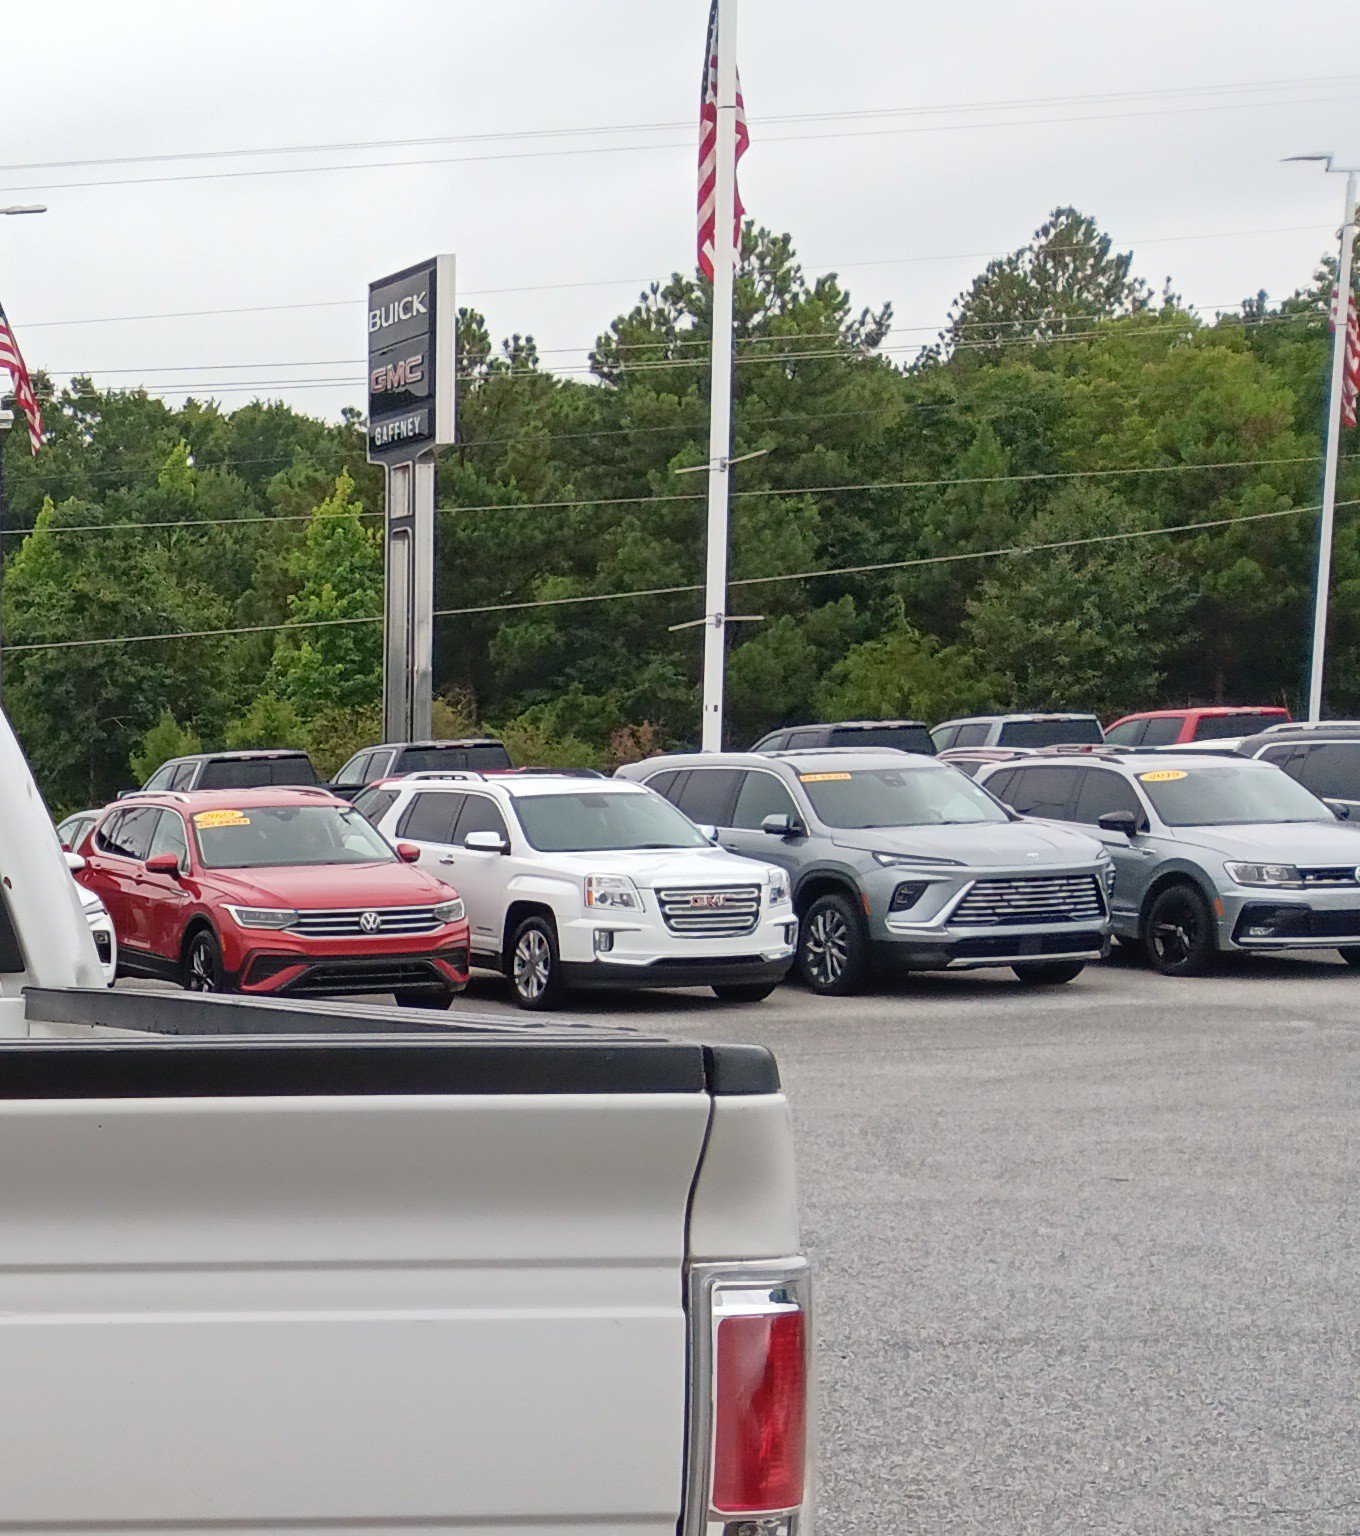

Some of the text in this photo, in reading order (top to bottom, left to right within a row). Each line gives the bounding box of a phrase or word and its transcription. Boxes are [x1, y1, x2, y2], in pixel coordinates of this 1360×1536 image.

[369, 291, 427, 332] BUICK
[371, 354, 423, 393] GMC
[374, 416, 421, 446] GAFFNEY
